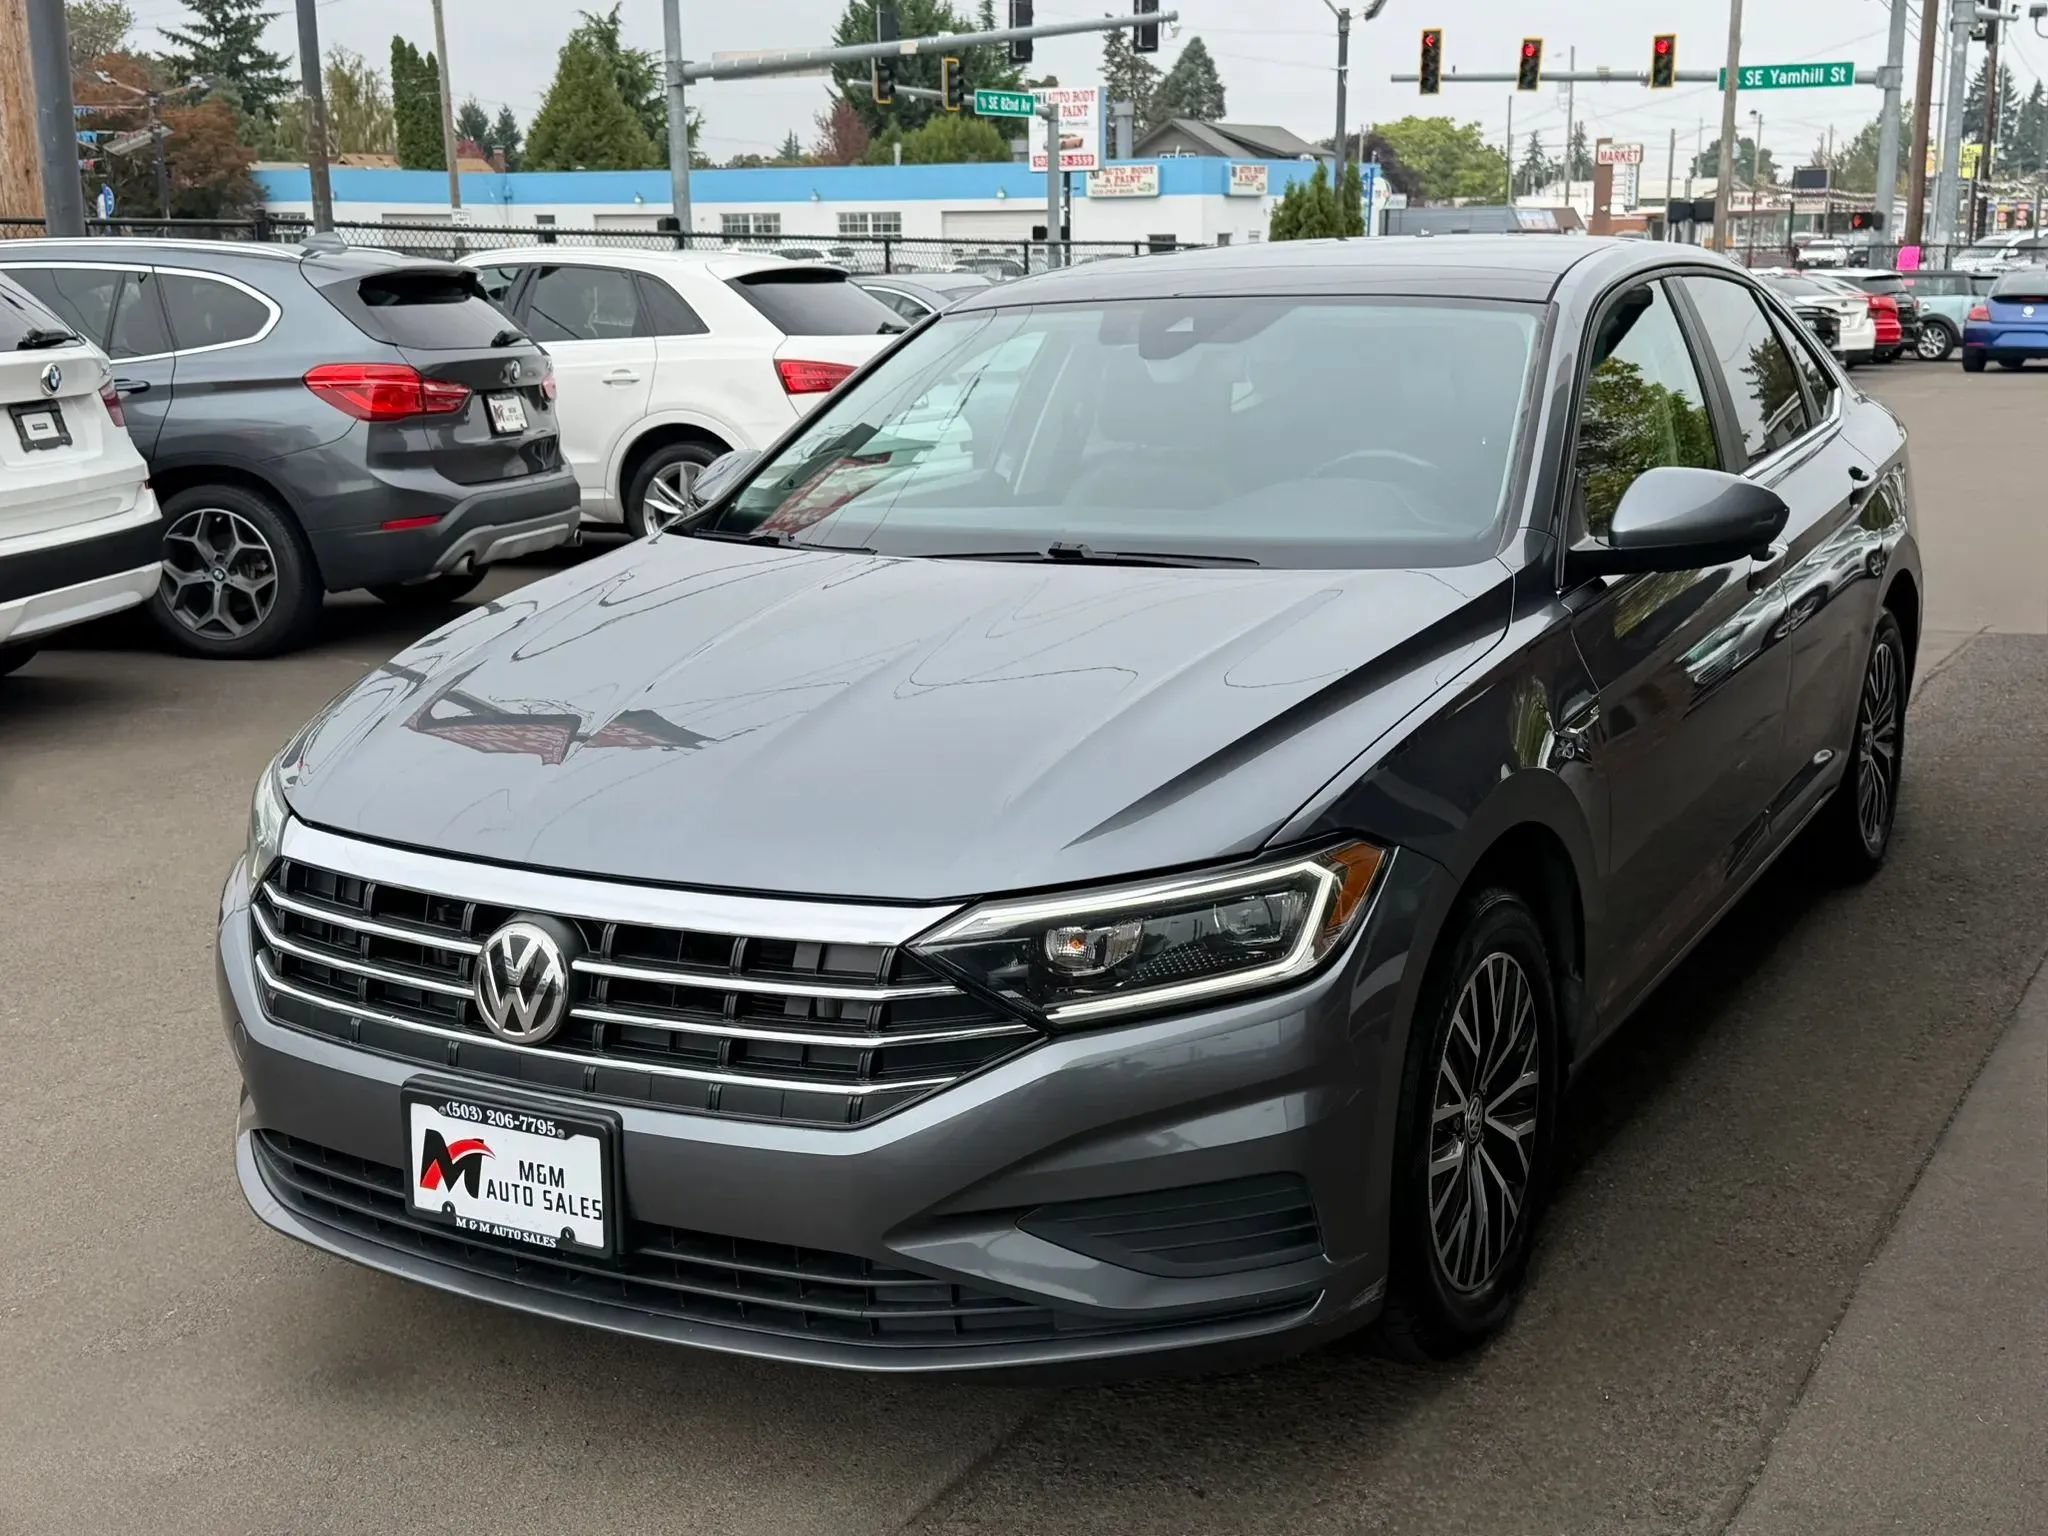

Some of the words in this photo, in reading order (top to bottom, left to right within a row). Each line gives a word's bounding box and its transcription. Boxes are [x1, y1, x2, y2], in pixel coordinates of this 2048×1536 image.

[1745, 70, 1764, 86] SE
[1770, 67, 1824, 85] Yamhill
[1830, 66, 1846, 82] St
[988, 96, 999, 110] SE
[1000, 96, 1019, 111] 82nd
[1072, 90, 1095, 103] BODY
[1062, 105, 1088, 117] PAINT
[1600, 151, 1639, 162] MARKET
[446, 1102, 482, 1122] (503)
[487, 1110, 556, 1137] 206-7795
[519, 1160, 565, 1189] M&M
[486, 1179, 533, 1207] AUTO
[543, 1190, 603, 1221] SALES
[456, 1217, 466, 1229] M
[469, 1219, 477, 1230] &
[479, 1222, 490, 1234] M
[492, 1226, 521, 1240] AUTO
[523, 1232, 557, 1248] SALES
